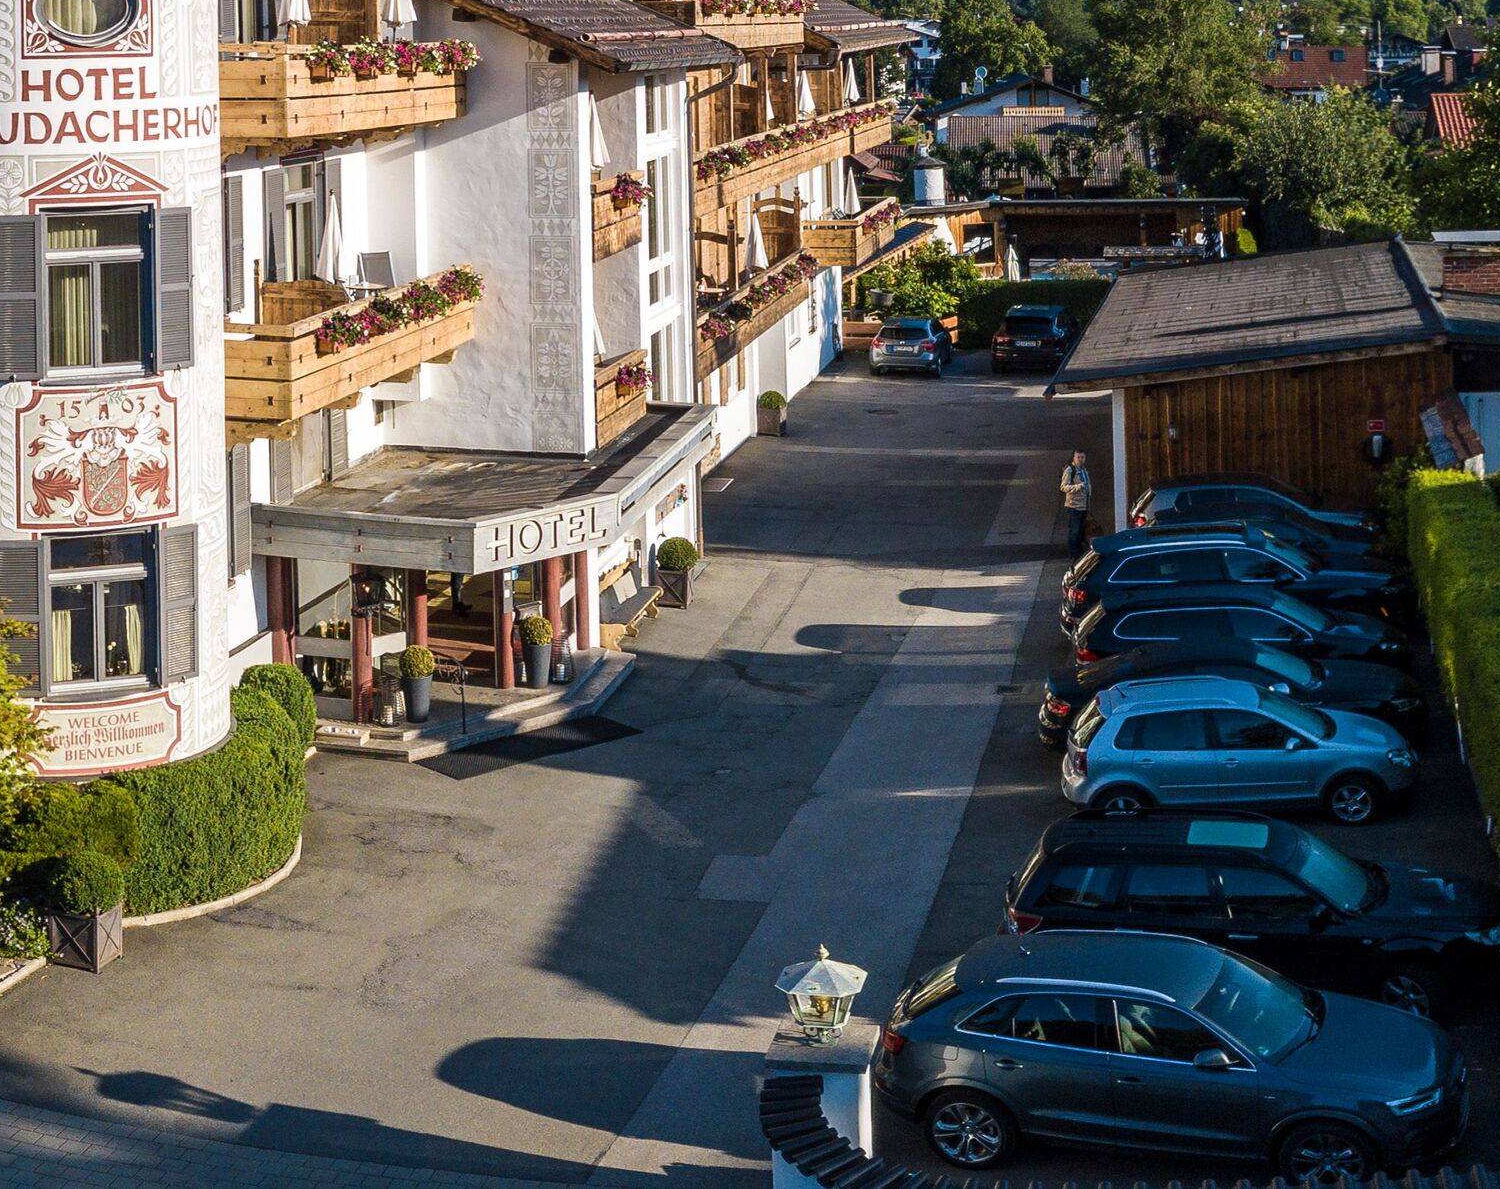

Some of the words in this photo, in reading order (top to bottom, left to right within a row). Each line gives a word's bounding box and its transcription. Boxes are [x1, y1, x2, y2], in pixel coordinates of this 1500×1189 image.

[20, 66, 158, 102] HOTEL
[486, 506, 607, 562] HOTEL
[67, 711, 140, 729] WELCOME
[94, 722, 165, 744] Willkommen
[65, 742, 144, 762] BIENVENUE
